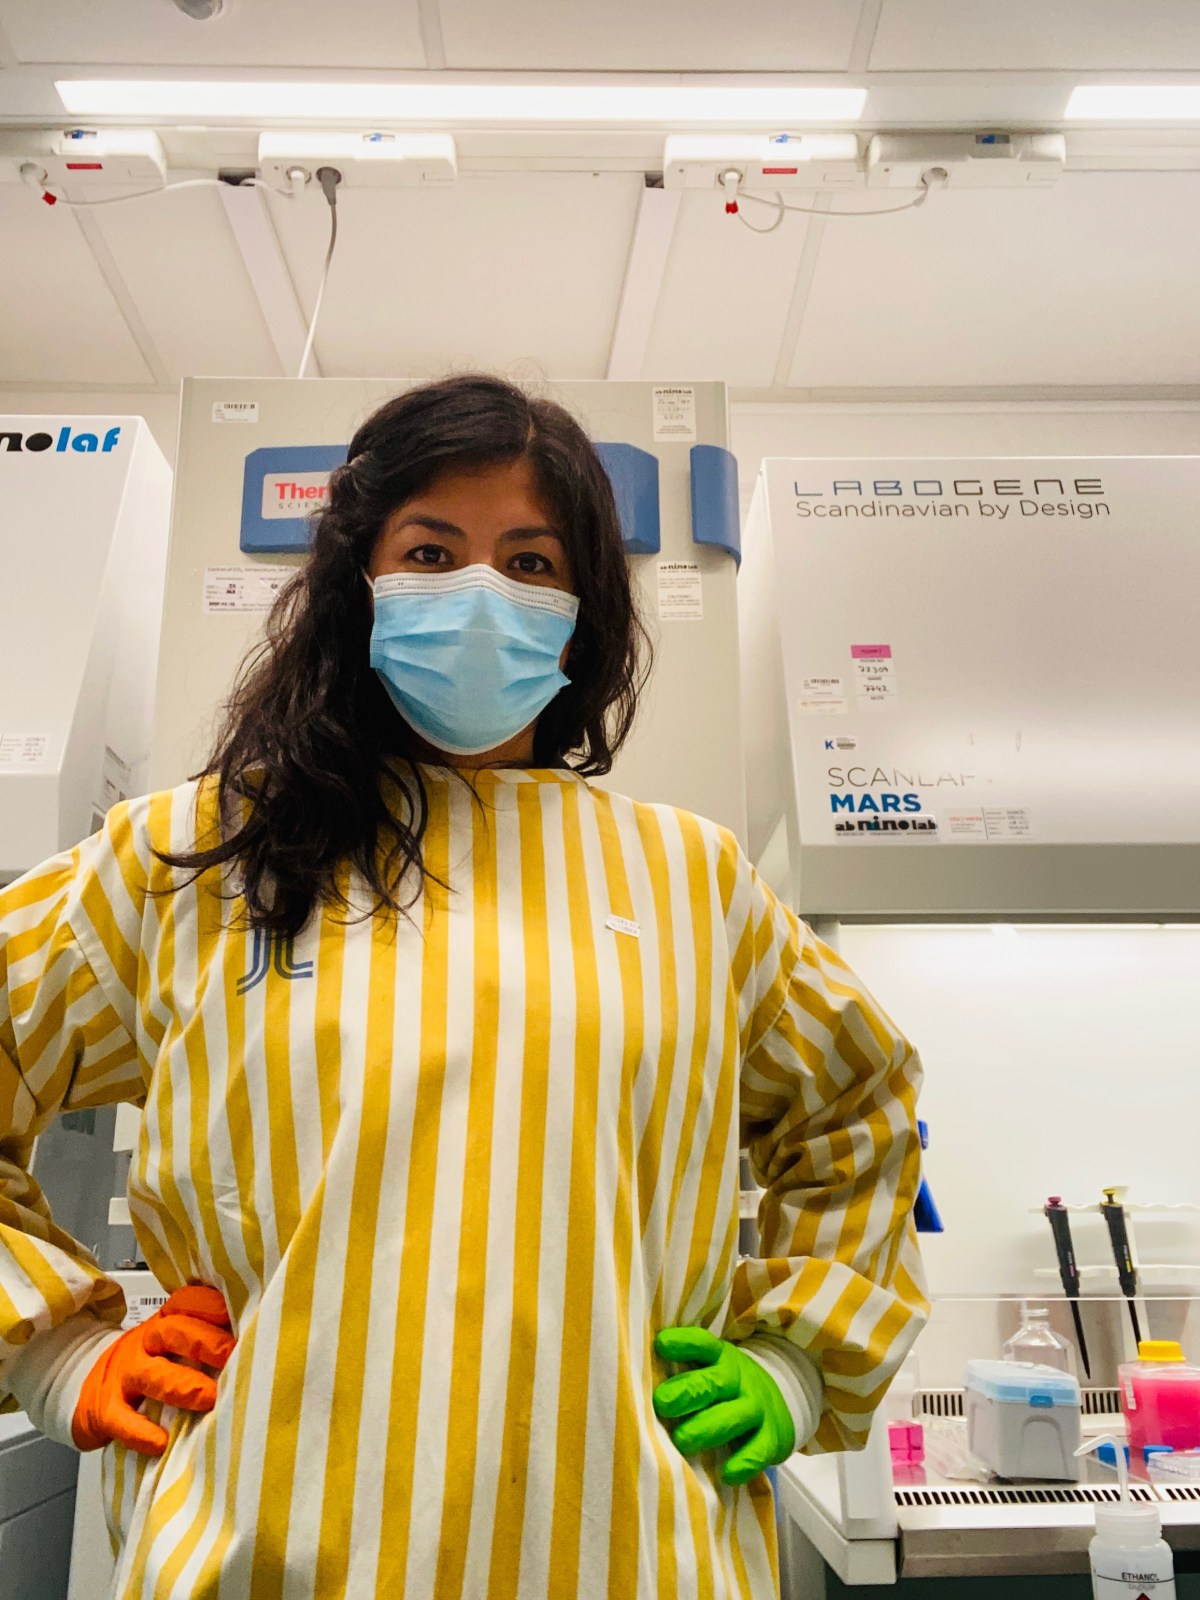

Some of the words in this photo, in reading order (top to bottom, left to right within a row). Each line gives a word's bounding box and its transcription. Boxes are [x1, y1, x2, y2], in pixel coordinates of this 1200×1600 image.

[275, 482, 334, 500] Ther
[794, 478, 1105, 496] LABOGENE
[796, 500, 969, 517] Scandinavian
[978, 500, 1010, 520] by
[1019, 499, 1111, 519] Design
[830, 793, 922, 813] MARS
